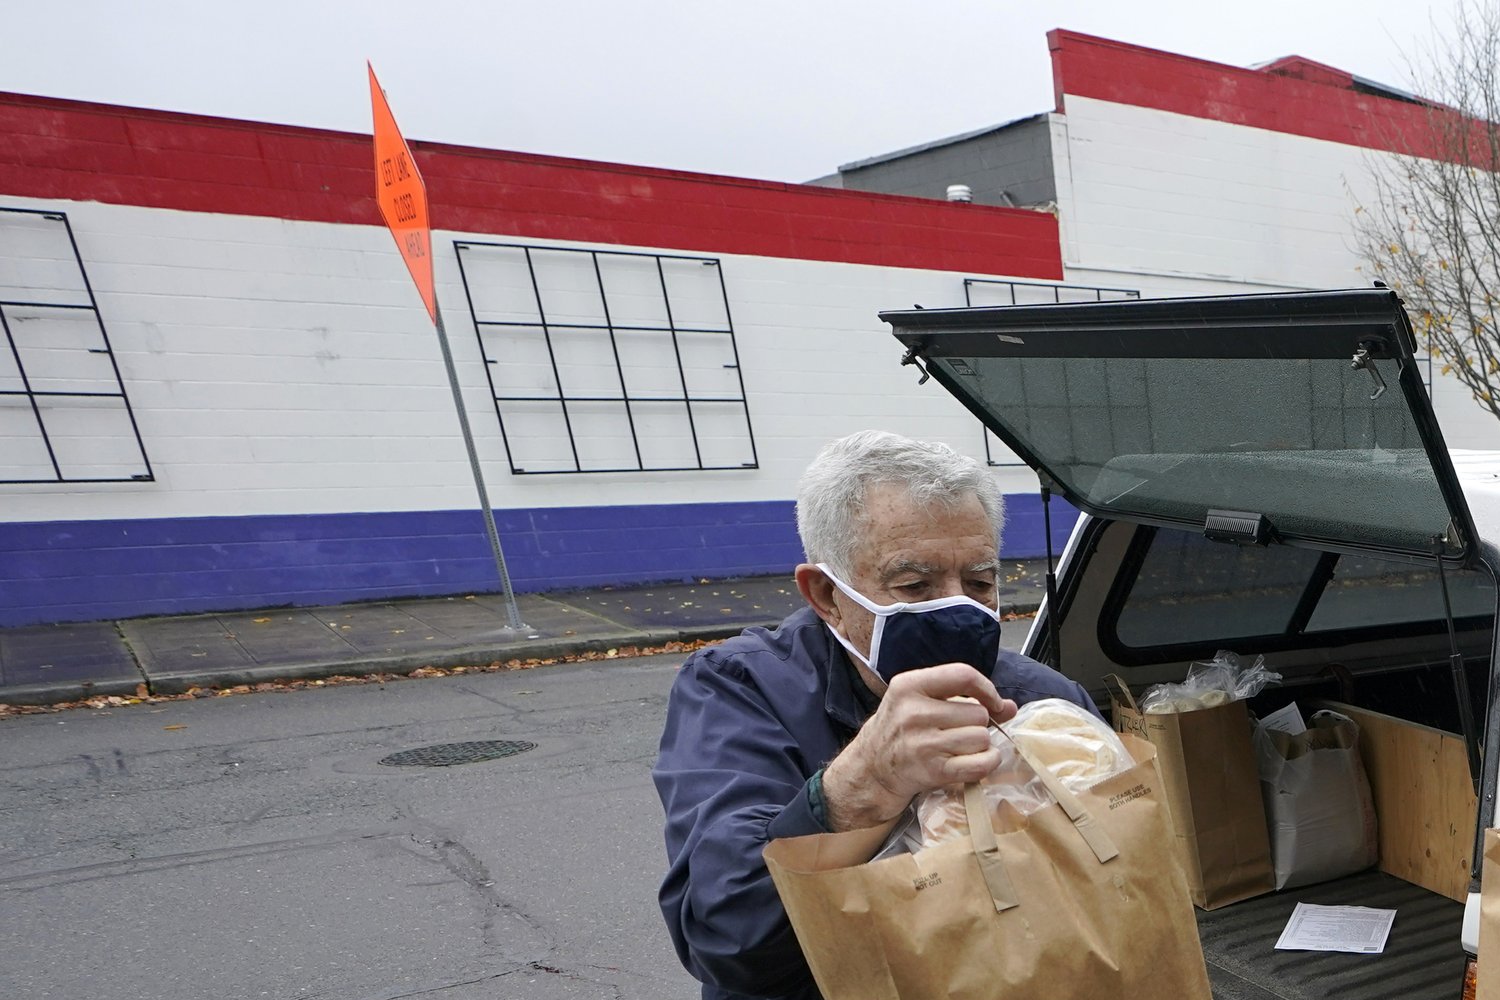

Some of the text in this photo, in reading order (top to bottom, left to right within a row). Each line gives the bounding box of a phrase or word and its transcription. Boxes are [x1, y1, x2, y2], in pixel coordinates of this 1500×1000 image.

[1108, 787, 1152, 810] BOTH HANDLES
[1109, 789, 1131, 803] PLEASE
